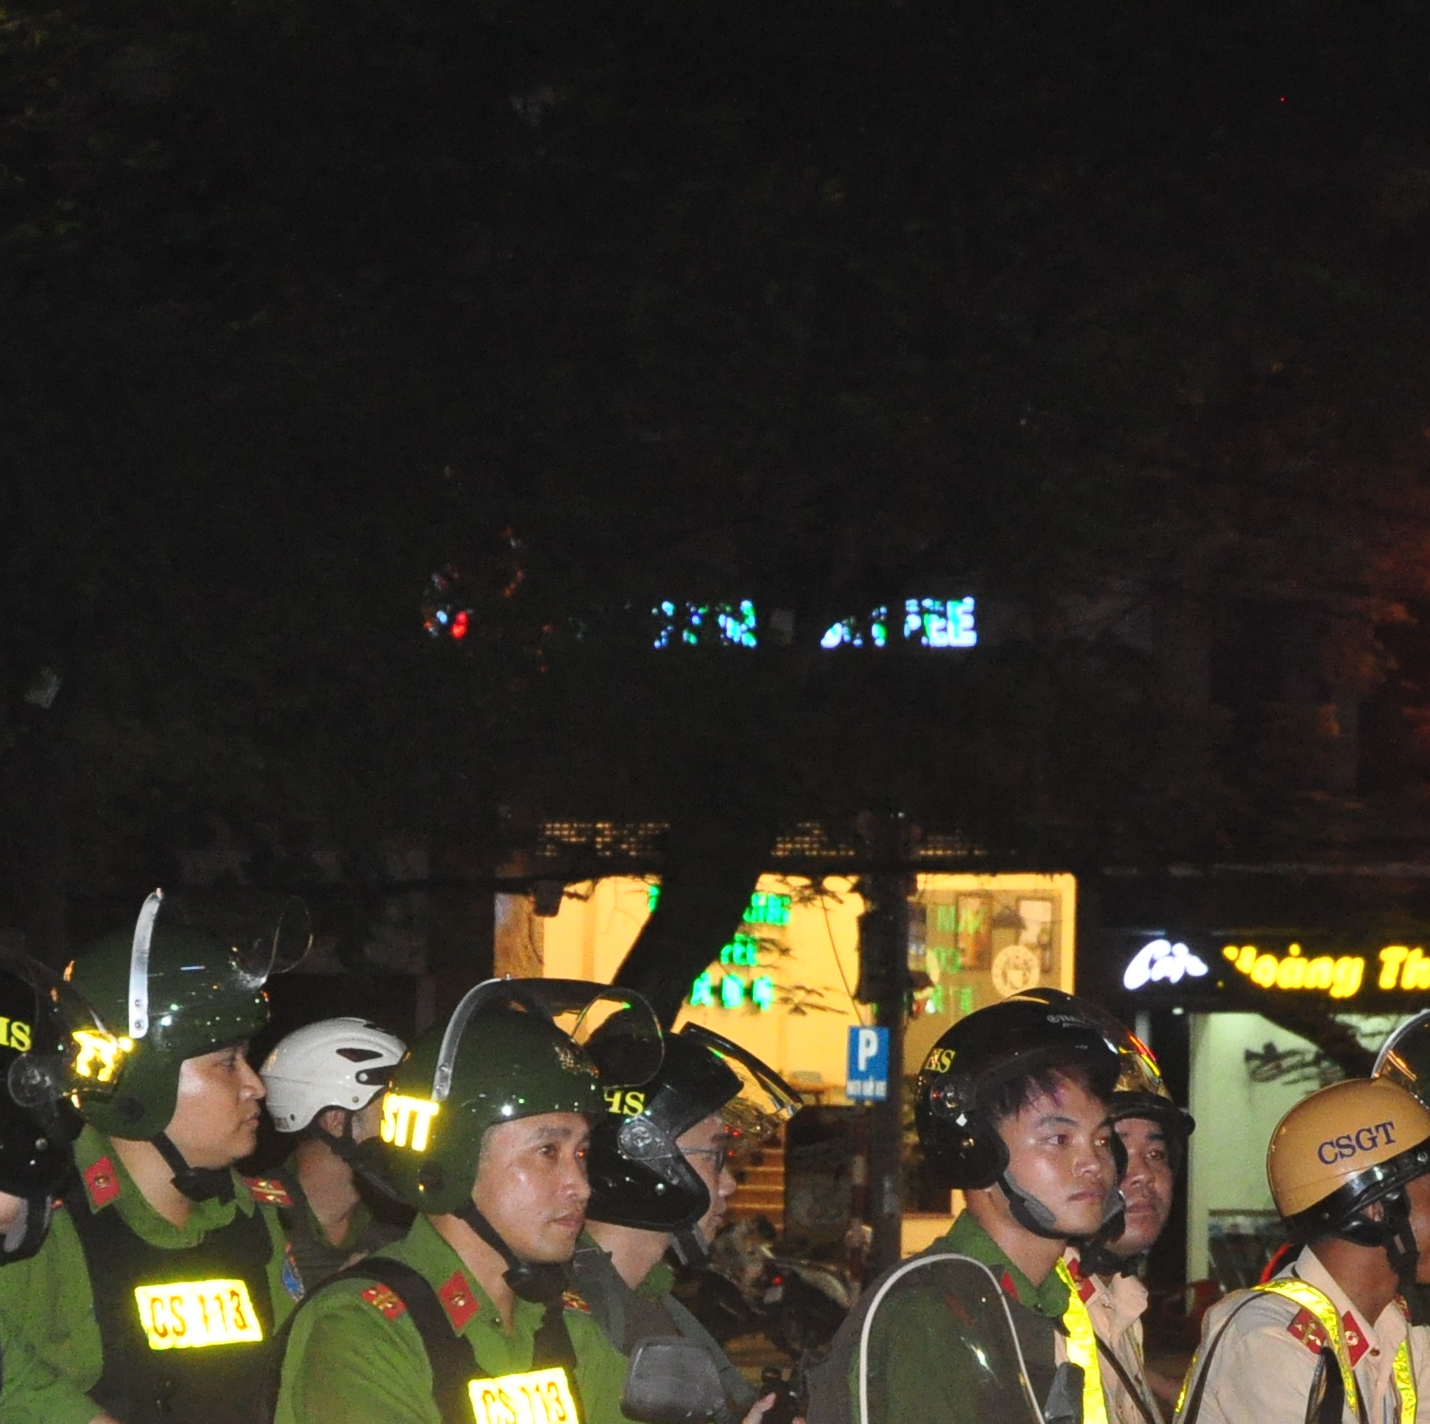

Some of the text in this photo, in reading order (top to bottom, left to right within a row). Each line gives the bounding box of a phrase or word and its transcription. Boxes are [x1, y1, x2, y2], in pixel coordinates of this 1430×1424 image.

[858, 1028, 879, 1072] P
[1317, 1121, 1396, 1165] CSGT
[150, 1296, 187, 1338] CS
